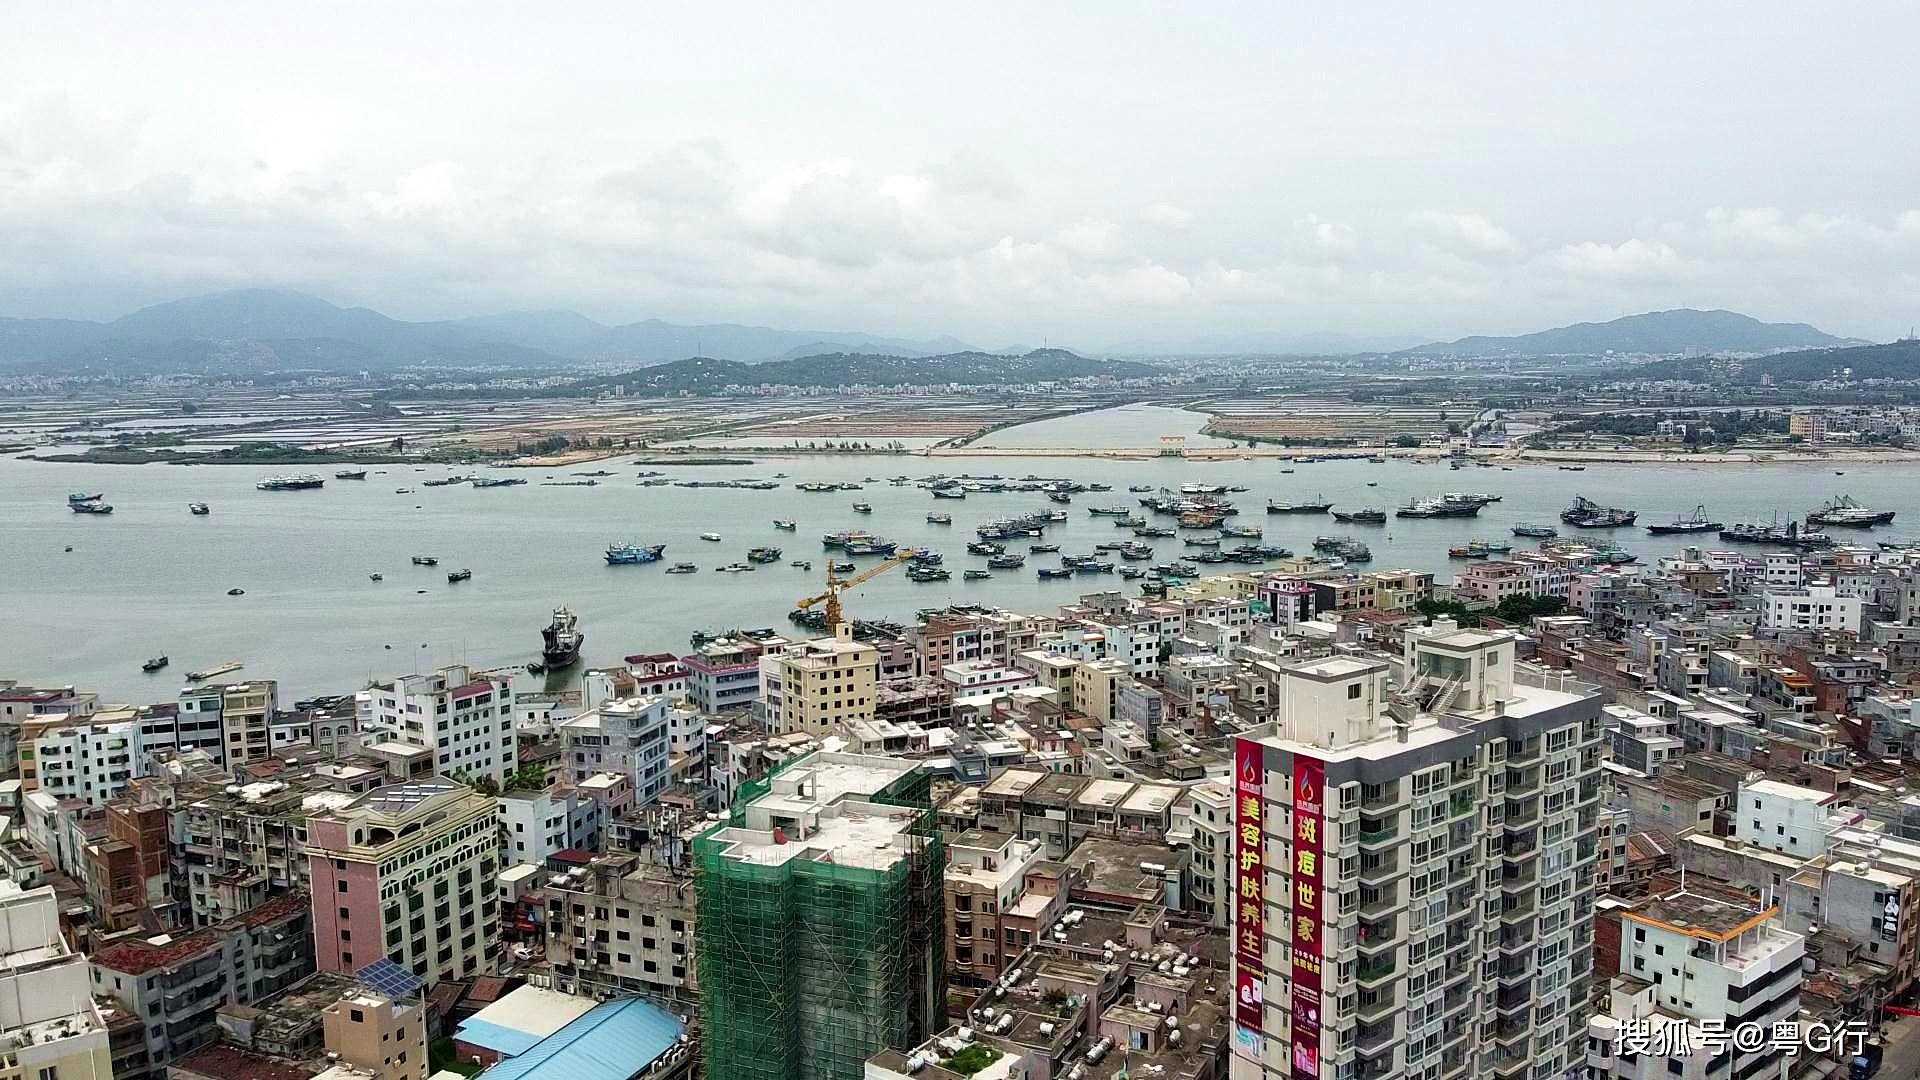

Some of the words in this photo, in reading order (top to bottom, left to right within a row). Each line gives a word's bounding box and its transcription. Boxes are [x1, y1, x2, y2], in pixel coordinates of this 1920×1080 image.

[1241, 796, 1260, 955] 美容护肤养生
[1297, 815, 1317, 943] 斑痘世家
